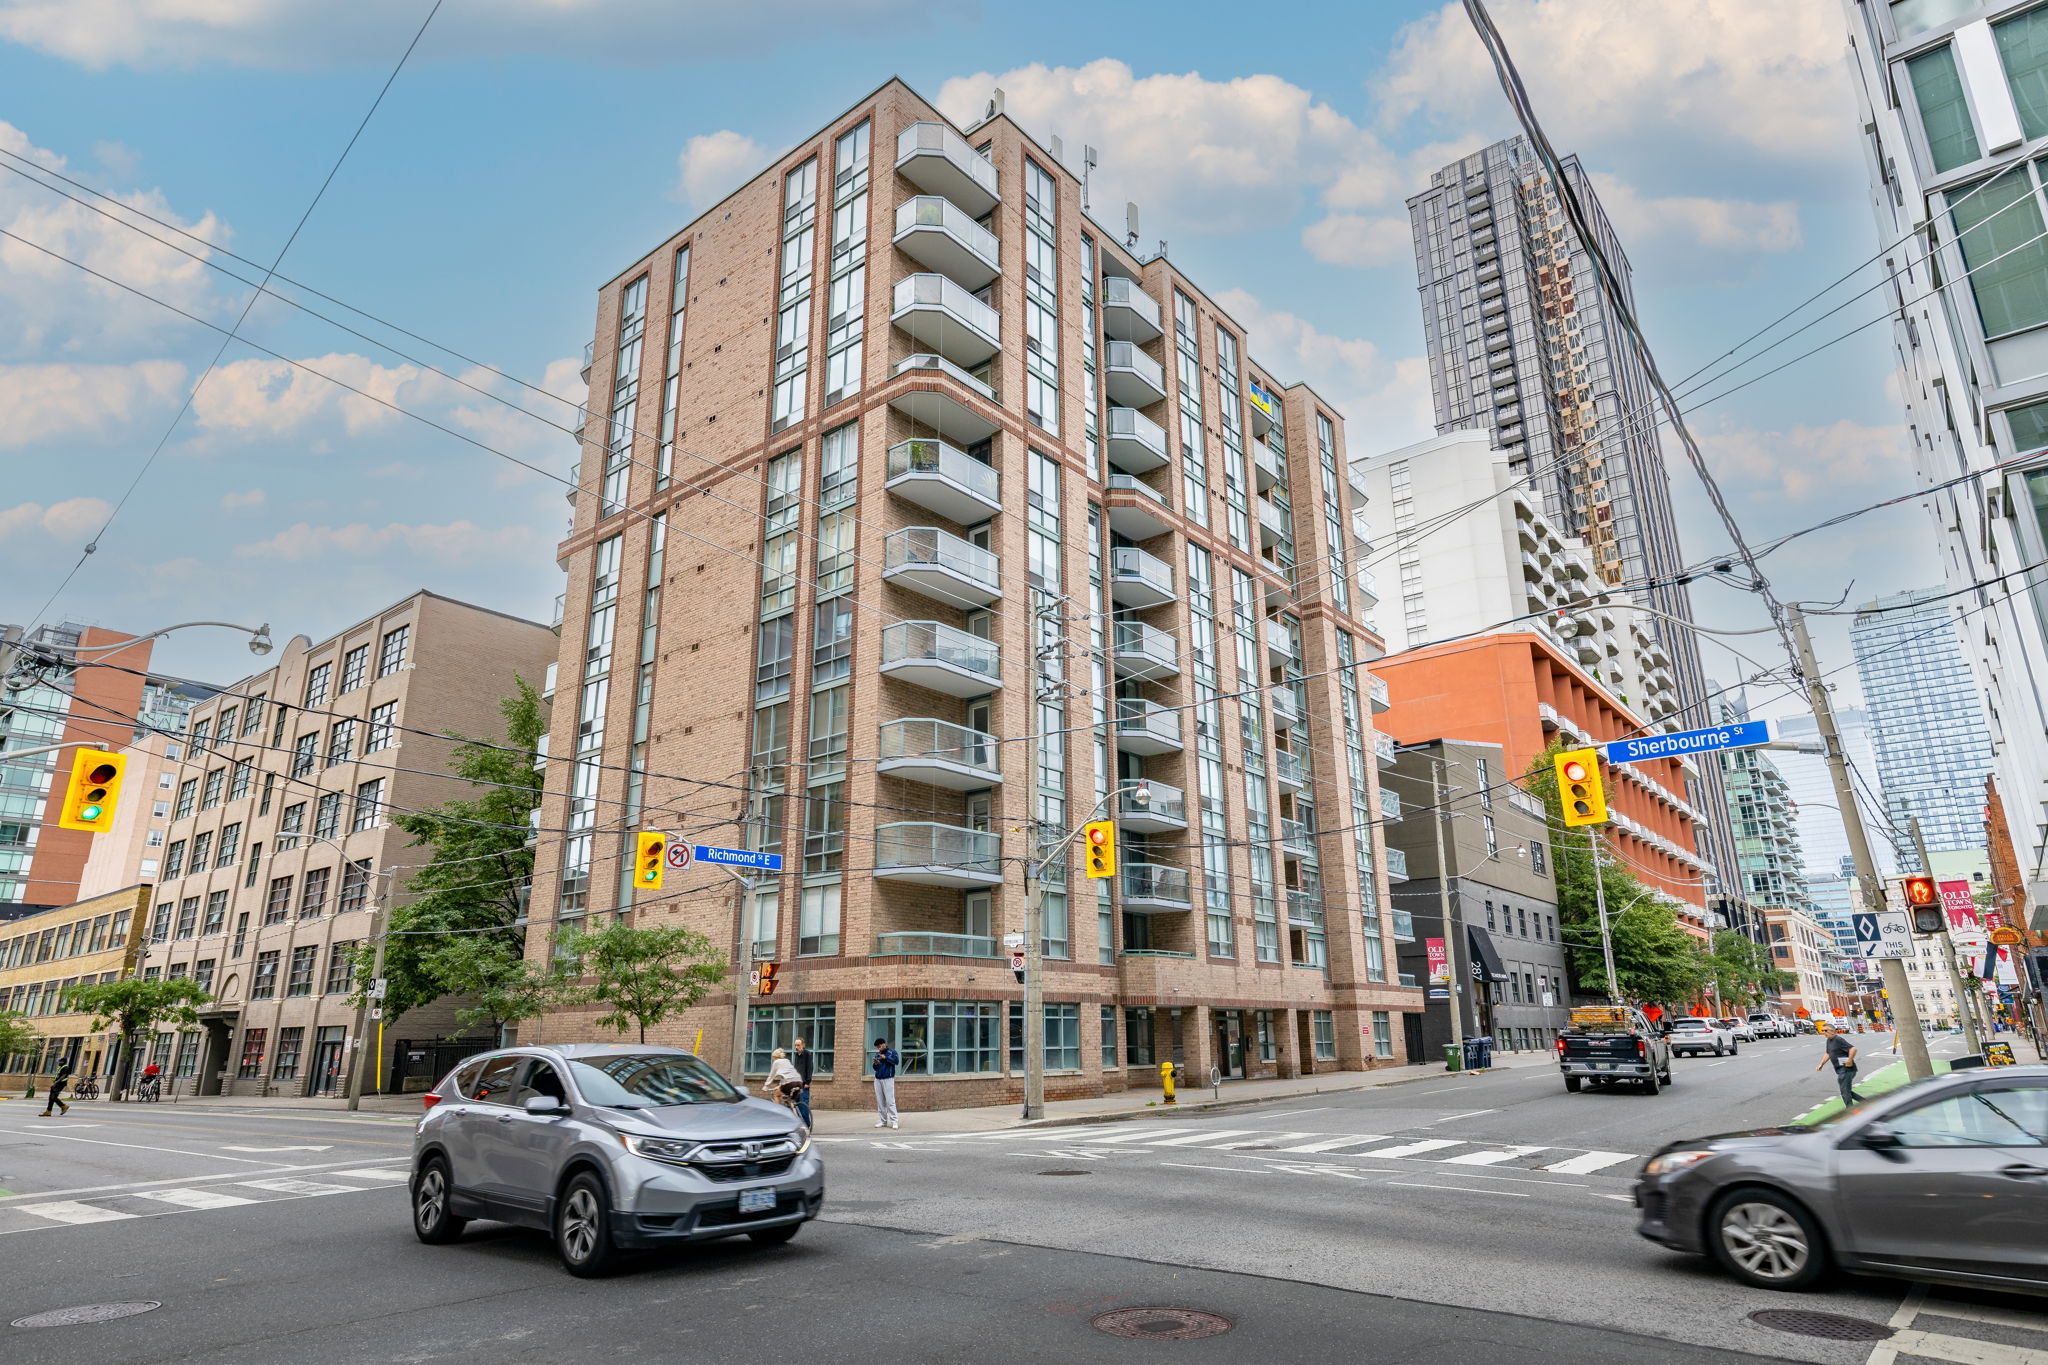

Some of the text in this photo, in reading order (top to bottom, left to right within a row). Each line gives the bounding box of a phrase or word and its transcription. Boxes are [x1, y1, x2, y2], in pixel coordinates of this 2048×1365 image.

[1627, 726, 1744, 757] Sherbourne St
[708, 848, 756, 864] Richmond
[764, 855, 770, 865] E
[1943, 890, 1970, 900] OLD
[1885, 941, 1904, 949] THIS
[1471, 961, 1483, 981] 287
